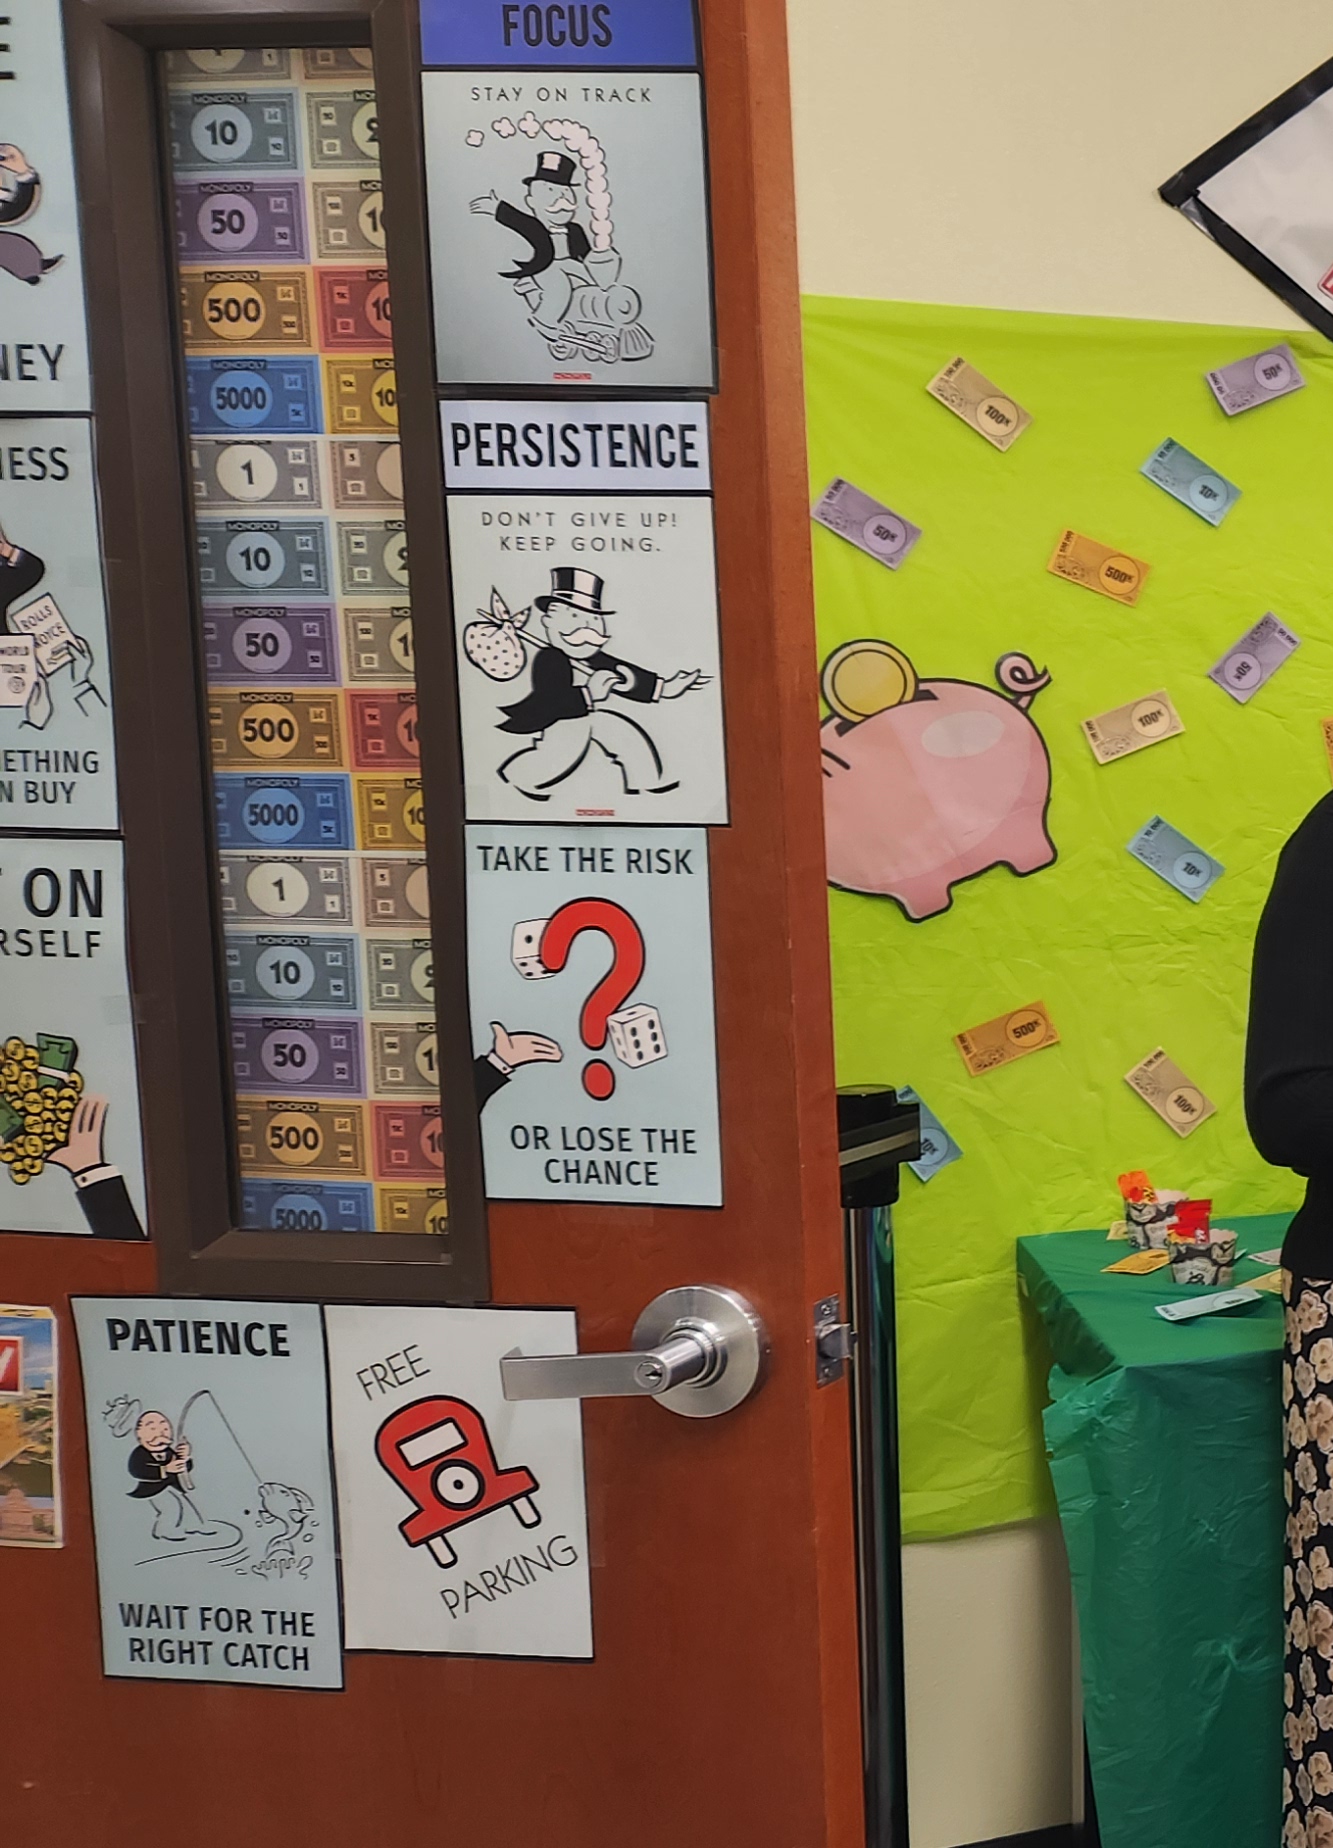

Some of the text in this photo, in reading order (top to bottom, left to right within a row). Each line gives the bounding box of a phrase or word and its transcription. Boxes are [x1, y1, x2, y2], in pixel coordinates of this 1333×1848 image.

[502, 4, 612, 47] FOCUS
[193, 94, 246, 104] MONOPOLY
[471, 87, 652, 103] STAY ON TRACK
[205, 120, 238, 145] 10
[199, 183, 252, 193] MONOPOLY
[211, 210, 245, 234] 50
[205, 271, 260, 282] MONOPOLY
[208, 298, 261, 323] 500
[212, 360, 266, 370] MONOPOLY
[216, 387, 266, 410] 5000
[451, 422, 699, 469] PERSISTENCE
[0, 446, 69, 481] ESS
[241, 459, 254, 485] 1
[227, 522, 279, 531] MONOPOLY
[481, 512, 677, 528] DON'T GIVE UP!
[500, 536, 662, 552] KEEP GOING.
[239, 547, 271, 571] 10
[20, 605, 53, 630] ROLLS
[234, 608, 285, 617] MONOPOLY
[245, 633, 279, 657] 50
[240, 693, 294, 703] MONOPOLY
[243, 718, 294, 742] 500
[0, 750, 99, 773] ETHING
[24, 781, 76, 803] BUY
[246, 778, 299, 788] MONOPOLY
[249, 804, 298, 826] 5000
[477, 845, 694, 875] TAKE THE RISK
[23, 867, 104, 918] ON
[272, 877, 285, 901] 1
[257, 936, 309, 946] MONOPOLY
[269, 960, 300, 984] 10
[263, 1019, 314, 1029] MONOPOLY
[274, 1044, 306, 1067] 50
[267, 1102, 318, 1112] MONOPOLY
[270, 1126, 319, 1150] 500
[510, 1124, 697, 1154] OR LOSE THE
[544, 1158, 659, 1186] CHANCE
[276, 1209, 322, 1230] 5000
[106, 1318, 290, 1357] PATIENCE
[356, 1344, 431, 1401] FREE
[440, 1535, 578, 1619] PARKING
[119, 1603, 315, 1637] WAIT FOR THE
[129, 1638, 309, 1671] RIGHT CATCH
